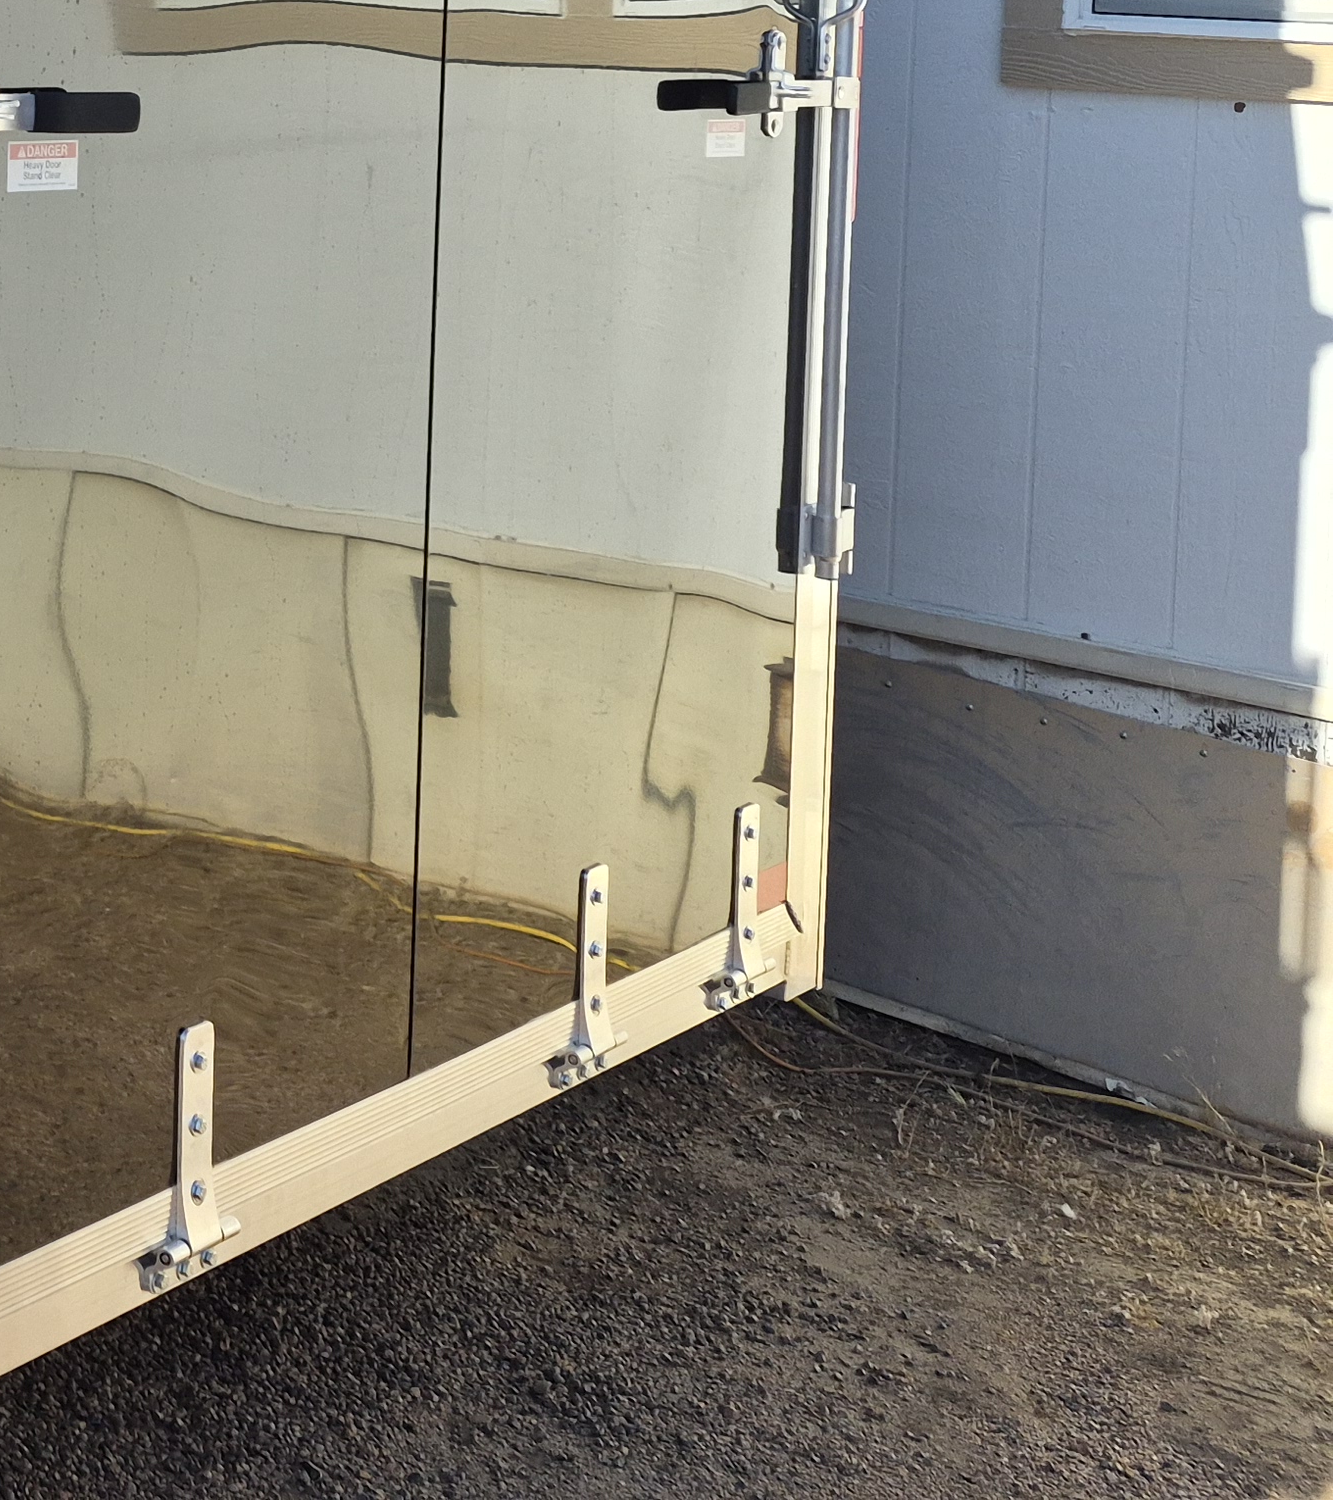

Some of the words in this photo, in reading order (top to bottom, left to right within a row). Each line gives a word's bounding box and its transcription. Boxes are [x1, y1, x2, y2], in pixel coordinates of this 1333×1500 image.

[26, 143, 68, 158] DANGER
[23, 160, 44, 170] Heavy
[45, 160, 61, 169] Door
[23, 171, 43, 180] Stand
[44, 171, 61, 180] Clear
